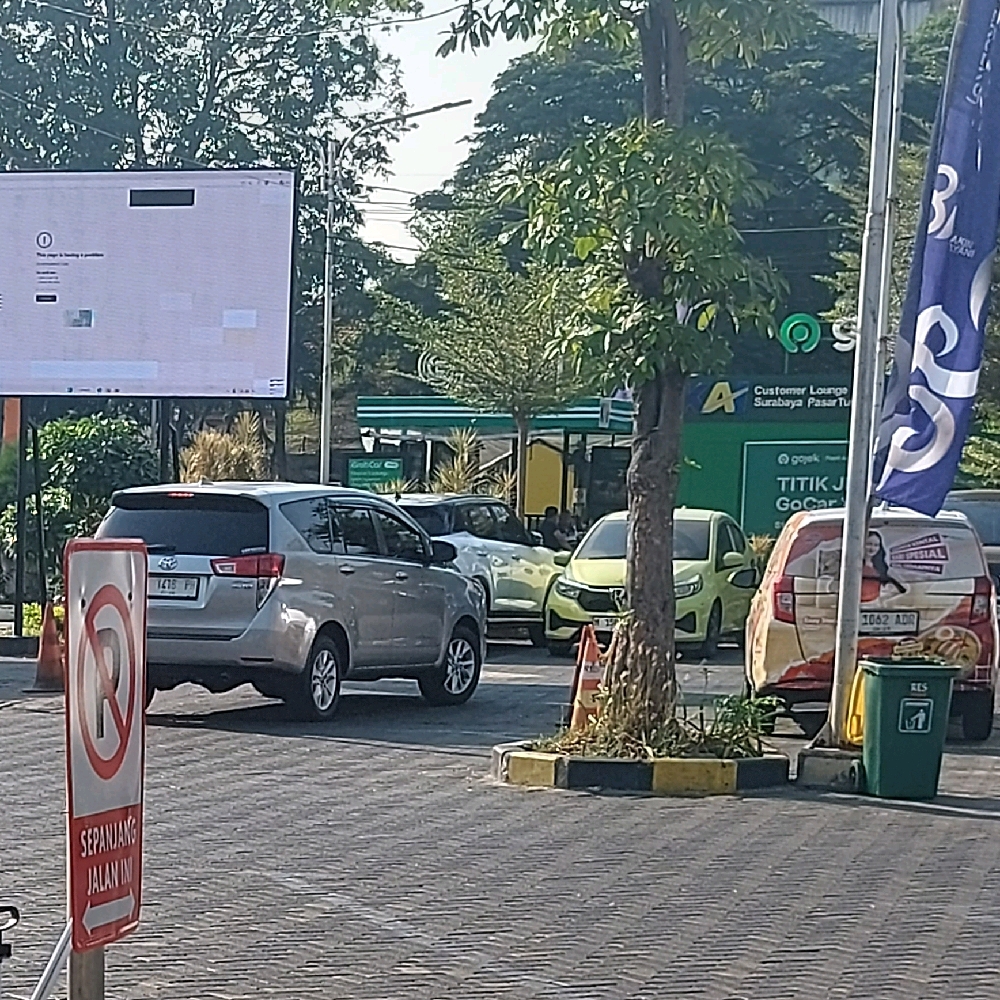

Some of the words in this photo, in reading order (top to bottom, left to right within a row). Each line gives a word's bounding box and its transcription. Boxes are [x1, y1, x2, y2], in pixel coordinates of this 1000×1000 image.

[754, 385, 806, 395] Customer
[809, 385, 848, 397] Lounge
[754, 397, 803, 409] Surabaya
[807, 397, 850, 408] PasarTu
[791, 454, 820, 465] gojek
[776, 476, 829, 492] TITIK
[776, 496, 837, 511] GoCar
[906, 547, 946, 560] SPESIAL
[80, 817, 137, 858] SEPANJANG
[87, 861, 119, 897] JALAN
[121, 856, 133, 885] INI
